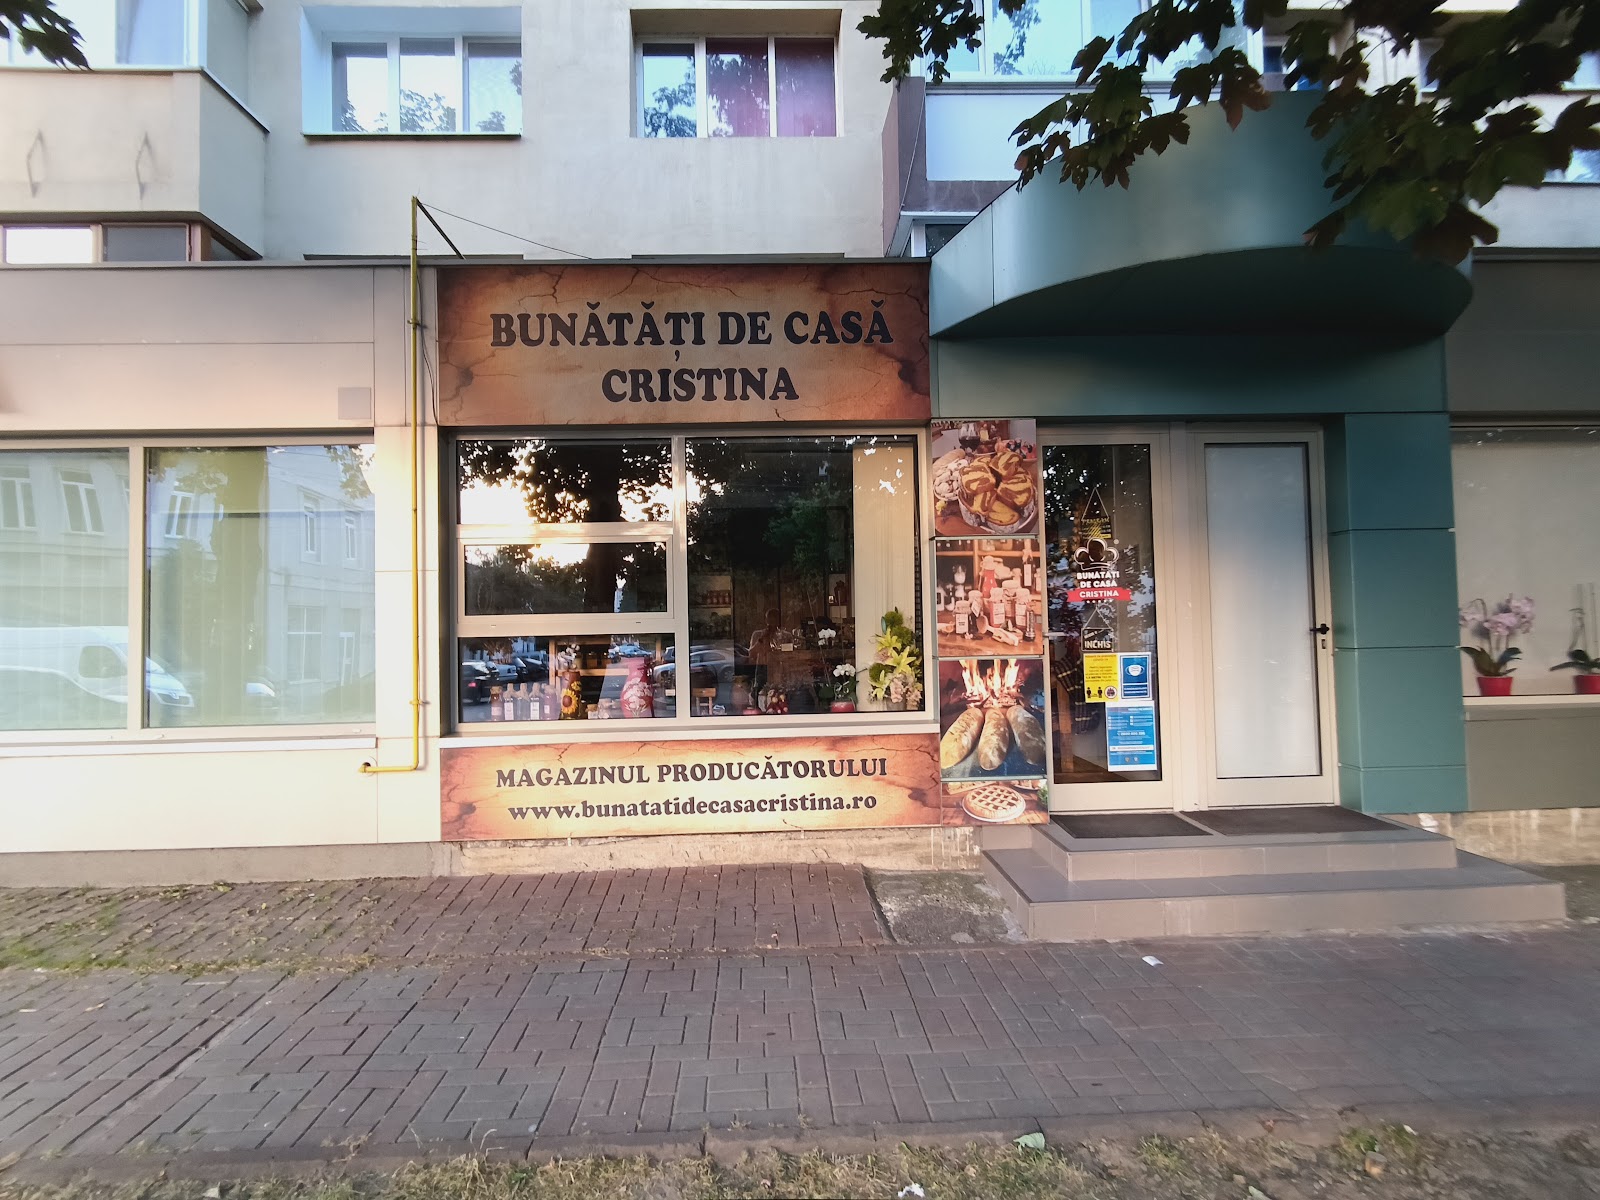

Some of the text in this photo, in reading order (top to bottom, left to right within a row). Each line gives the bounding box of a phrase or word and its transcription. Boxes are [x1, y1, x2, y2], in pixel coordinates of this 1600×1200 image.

[490, 299, 893, 361] BUNĂTĂȚI DE CASĂ
[602, 367, 799, 402] CRISTINA
[496, 756, 887, 788] MAGAZINUL PRODUCĂTORULUI
[508, 793, 877, 819] www.bunatatidecasacristina.ro
